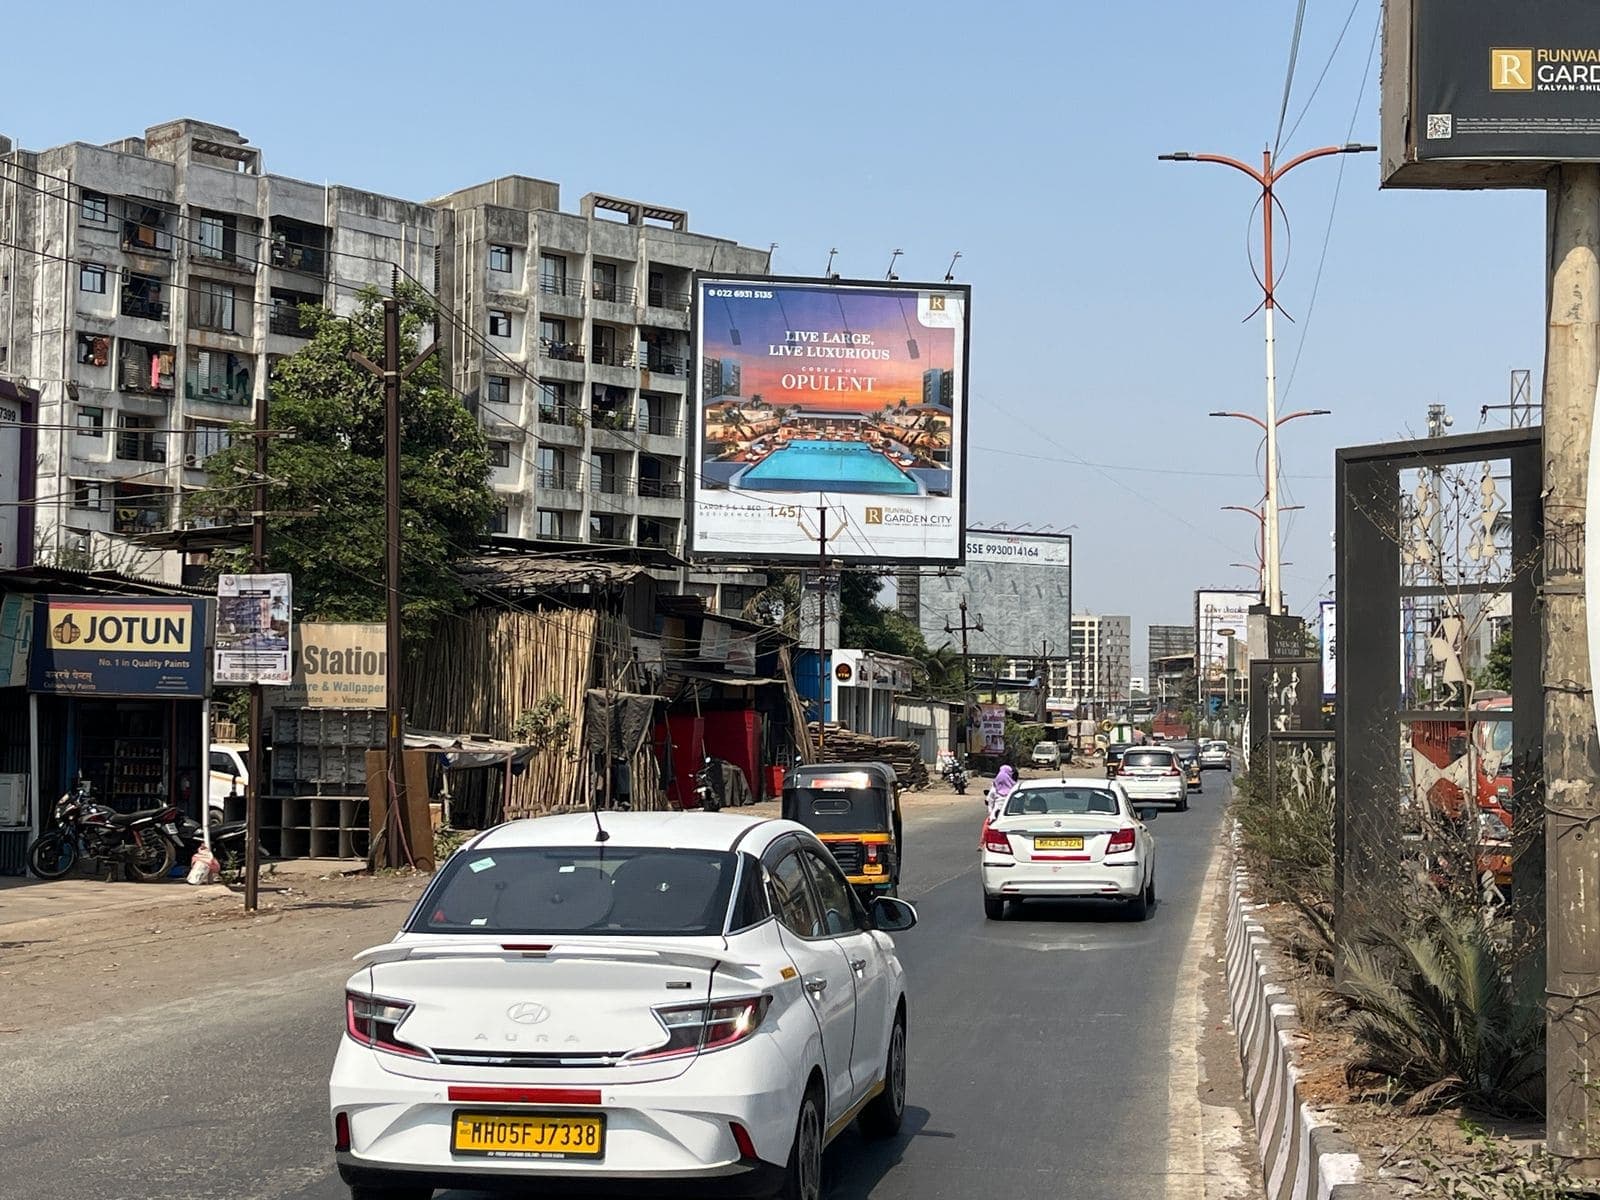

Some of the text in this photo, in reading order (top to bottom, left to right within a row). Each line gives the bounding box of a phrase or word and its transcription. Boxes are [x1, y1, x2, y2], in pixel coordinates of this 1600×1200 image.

[1537, 49, 1600, 62] RUNWA
[717, 289, 733, 298] 022
[785, 330, 875, 346] LIVE LARGE,
[769, 344, 890, 360] LIVE LUXURIOUS
[781, 373, 876, 393] OPULENT
[884, 513, 953, 524] GARDEN CITY
[986, 544, 1039, 557] 9930014164
[84, 615, 185, 644] JOTUN
[131, 659, 163, 669] Quality
[164, 660, 190, 669] Paints
[321, 681, 331, 692] &
[333, 681, 385, 694] Wallpaper
[474, 1032, 580, 1043] AURA
[471, 1120, 596, 1146] MH05FJ7338
